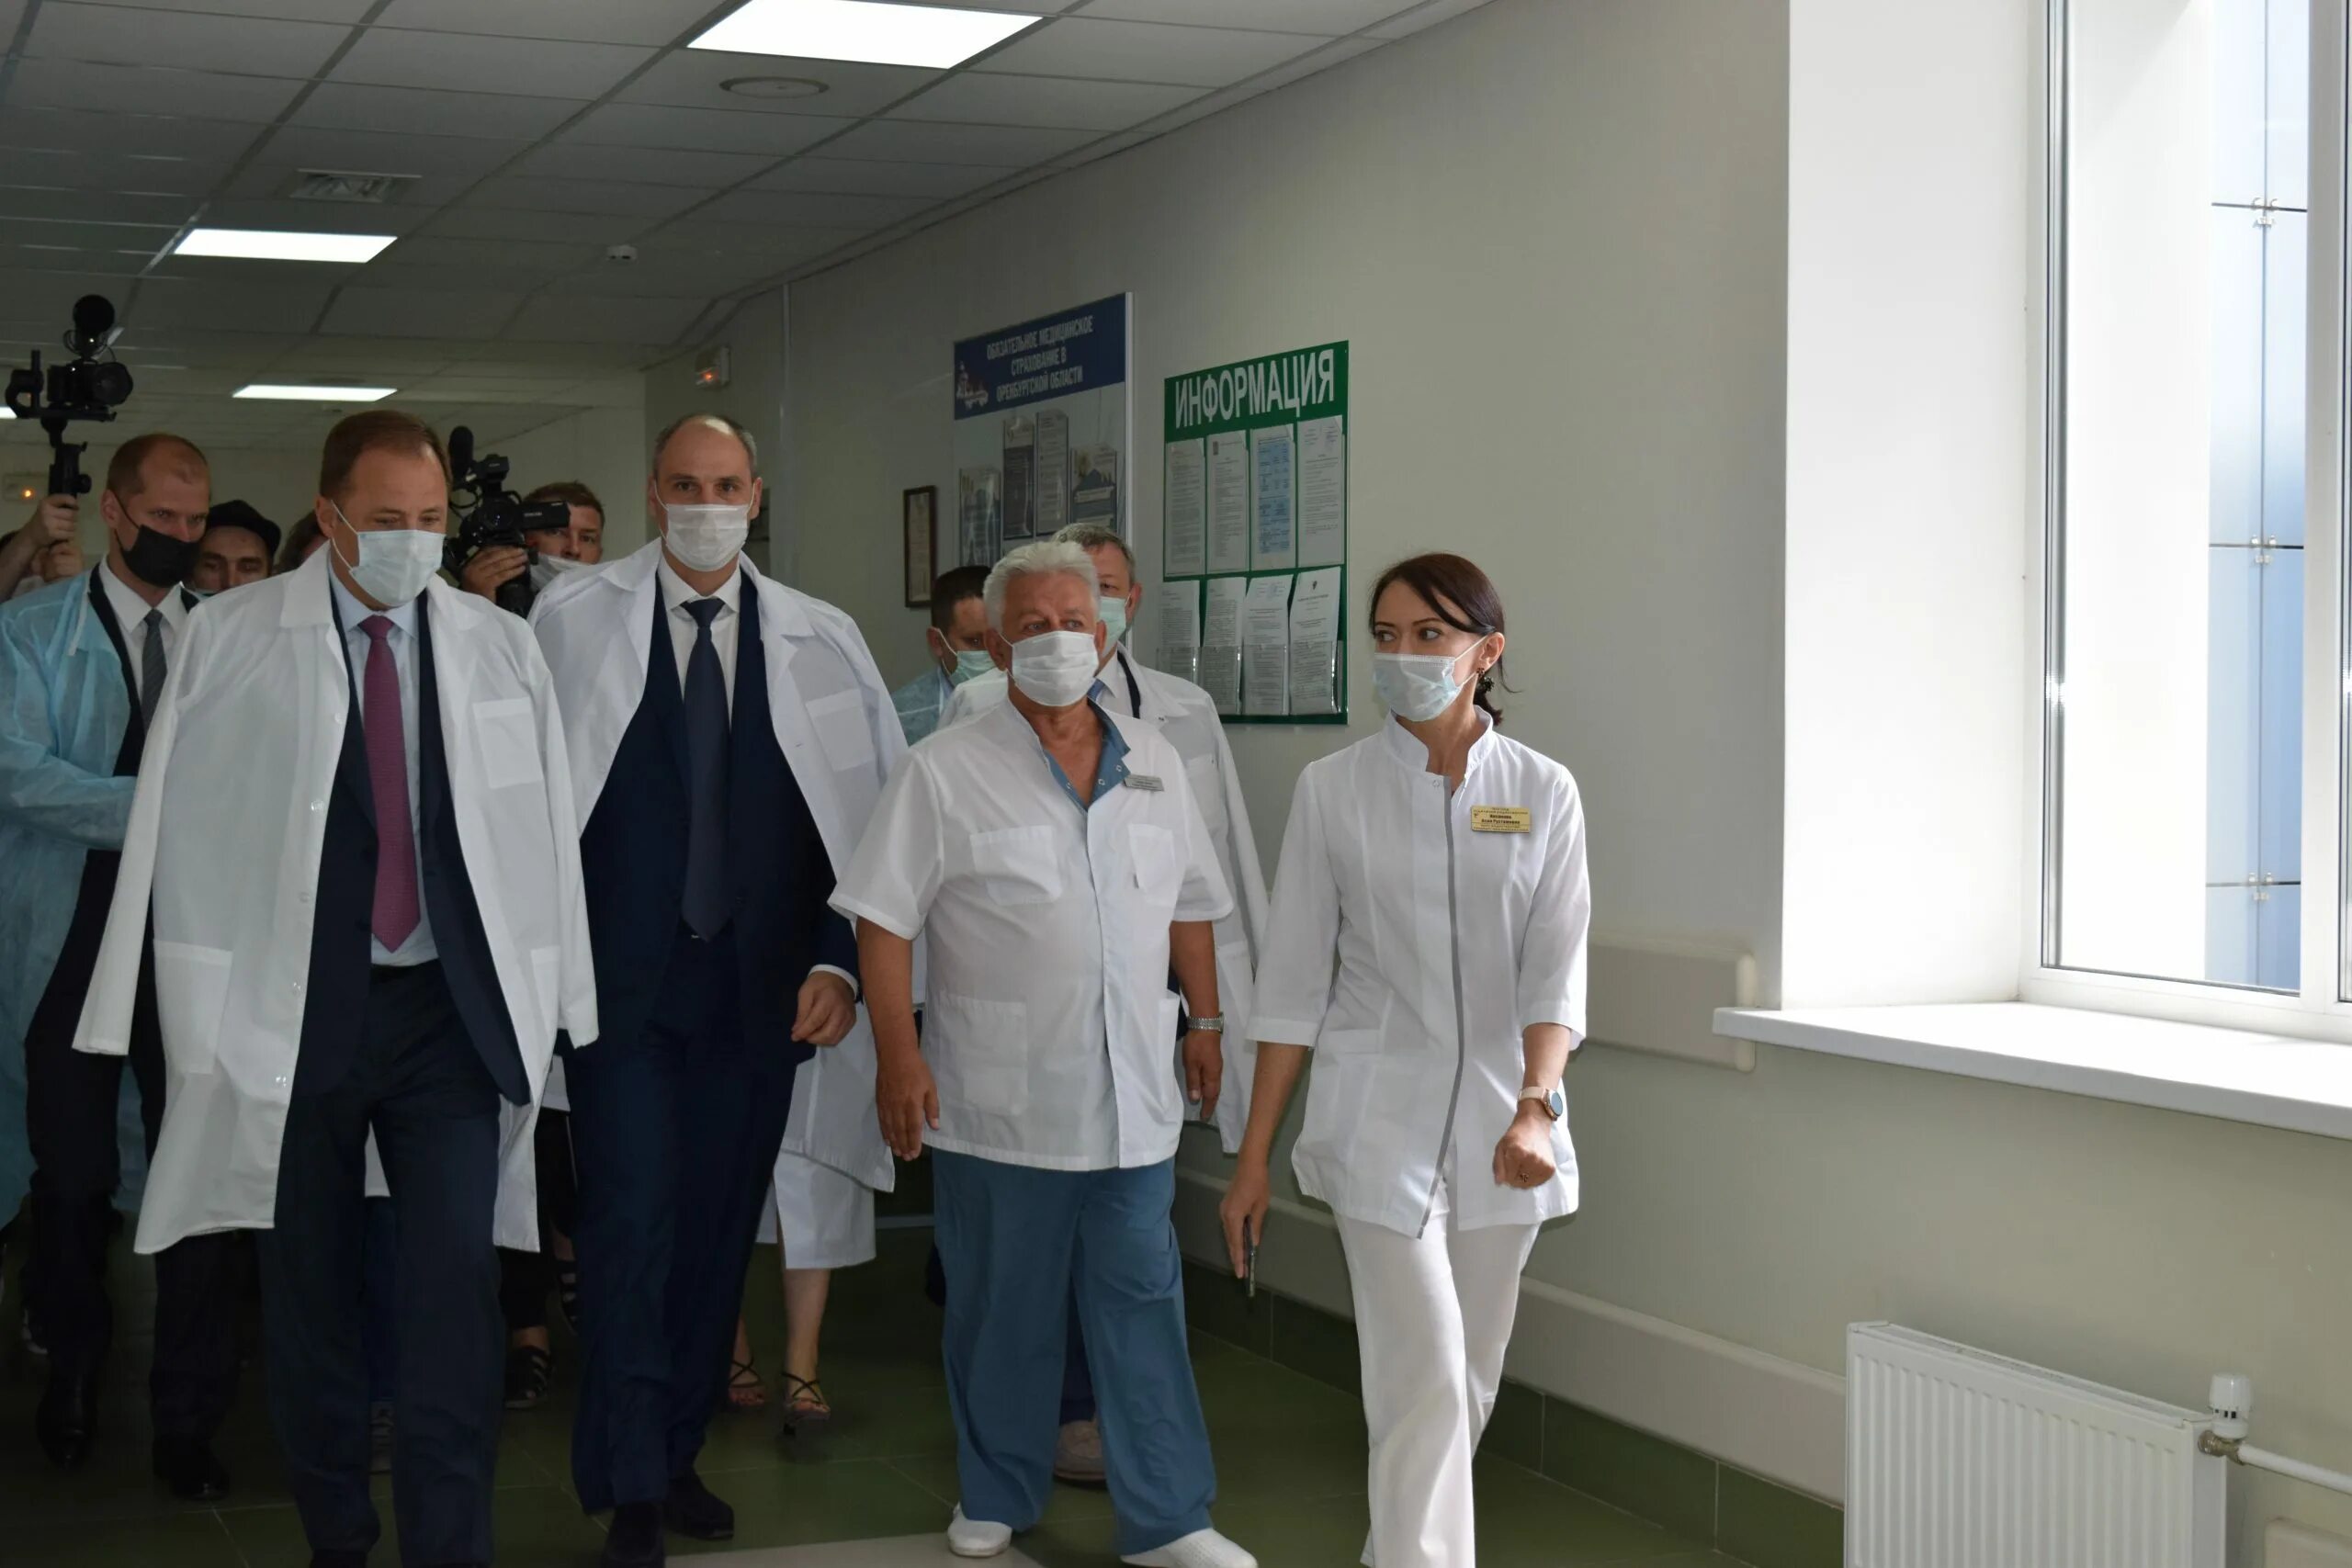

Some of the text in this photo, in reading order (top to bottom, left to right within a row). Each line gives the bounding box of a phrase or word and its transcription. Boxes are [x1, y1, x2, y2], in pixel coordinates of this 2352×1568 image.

[987, 315, 1094, 360] ОБЯЗАТЕЛЬНОЕ МЕДИЦИНСКОЕ
[1012, 345, 1067, 377] СТРАХОВАНИЕ В
[996, 366, 1084, 402] ОРЕНБУРГСКОЙ ОБЛАСТИ
[1175, 349, 1334, 429] ИНФОРМАЦИЯ
